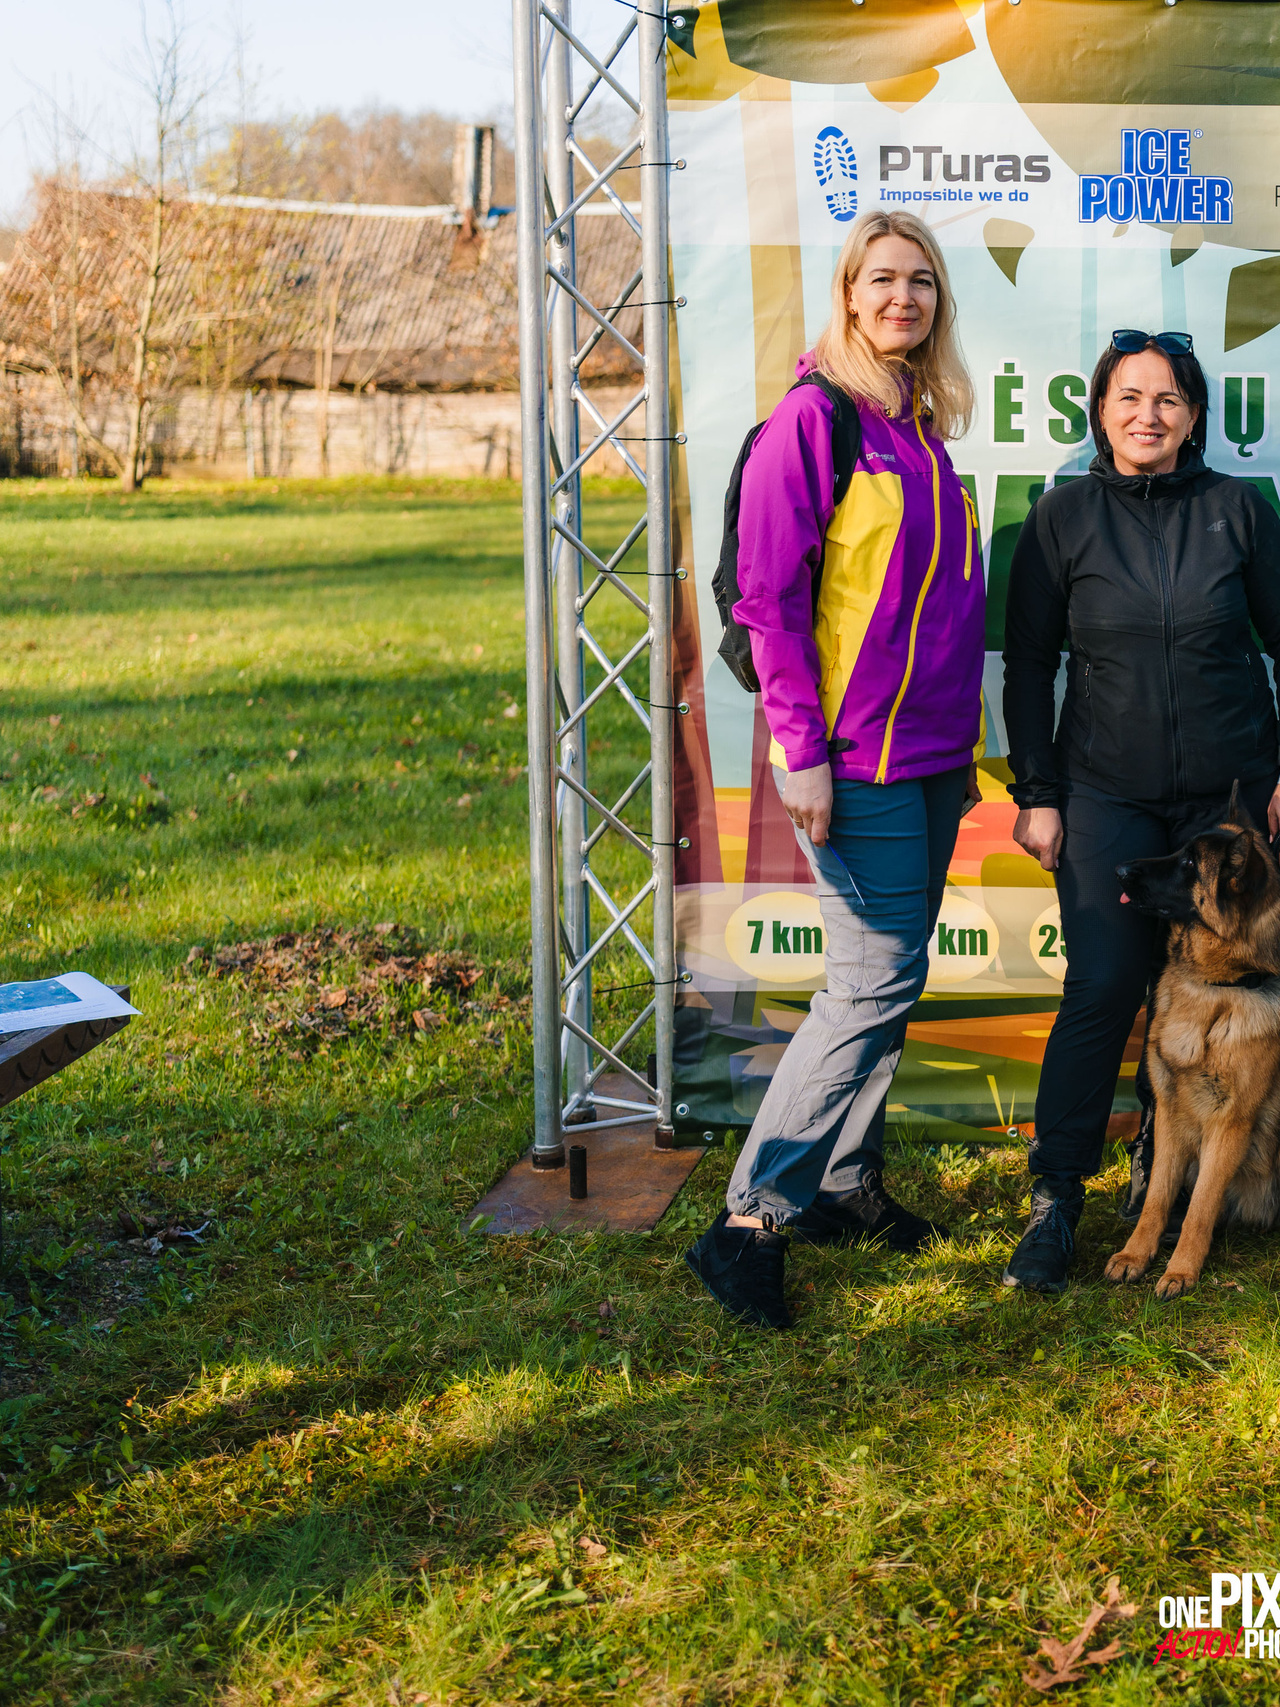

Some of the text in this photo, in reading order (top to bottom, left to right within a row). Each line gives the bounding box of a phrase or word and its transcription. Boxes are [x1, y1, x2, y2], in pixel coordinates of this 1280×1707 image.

[880, 145, 1051, 183] PTuras
[1121, 129, 1191, 176] ICE
[880, 188, 1029, 203] Impossible we do
[1079, 174, 1233, 224] POWER
[747, 920, 823, 954] 7 km
[938, 922, 988, 956] km
